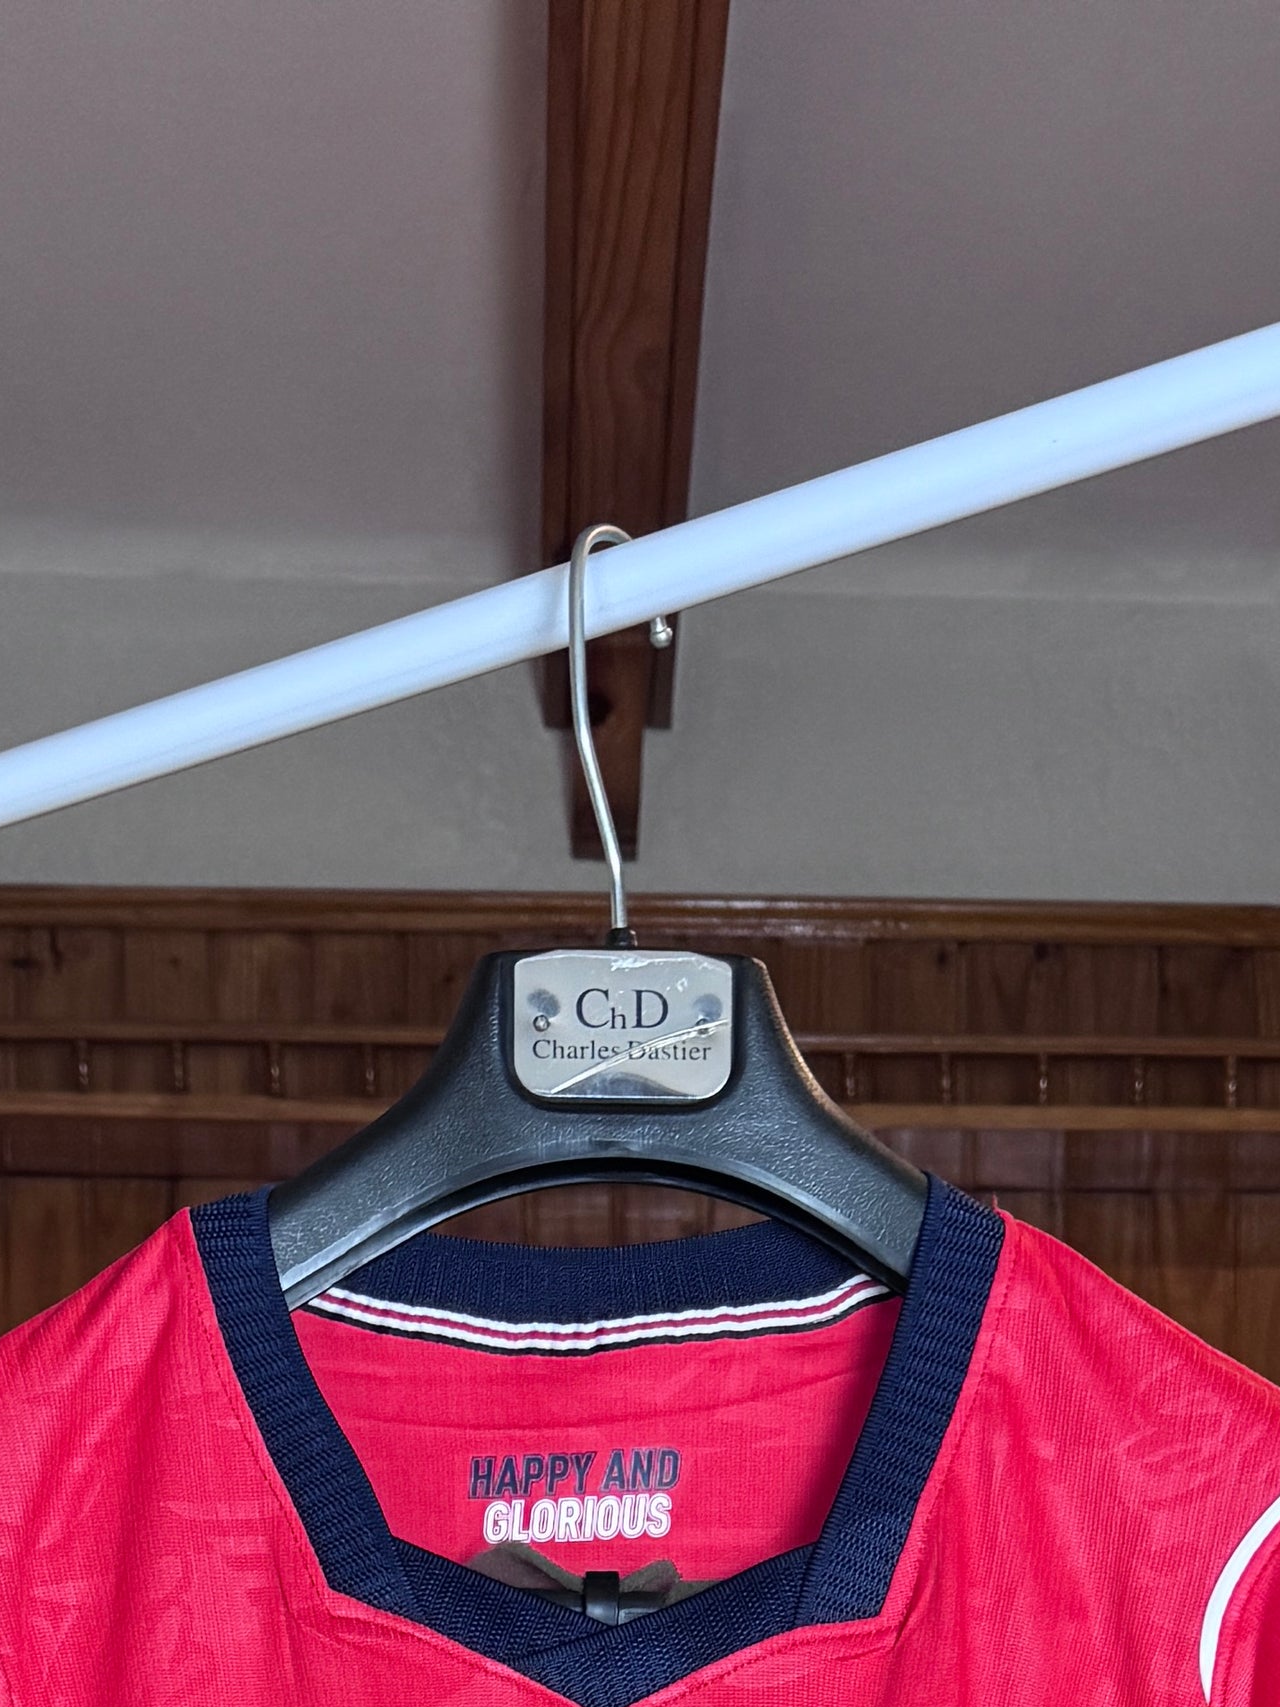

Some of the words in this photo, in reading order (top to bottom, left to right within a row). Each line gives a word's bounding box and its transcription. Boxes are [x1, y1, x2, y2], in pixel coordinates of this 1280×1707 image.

[575, 988, 669, 1030] ChD
[532, 1039, 619, 1061] Charles
[628, 1041, 712, 1062] Dastier
[469, 1451, 596, 1499] HAPPY
[600, 1446, 682, 1493] AND
[482, 1493, 672, 1544] GLORIOUS
